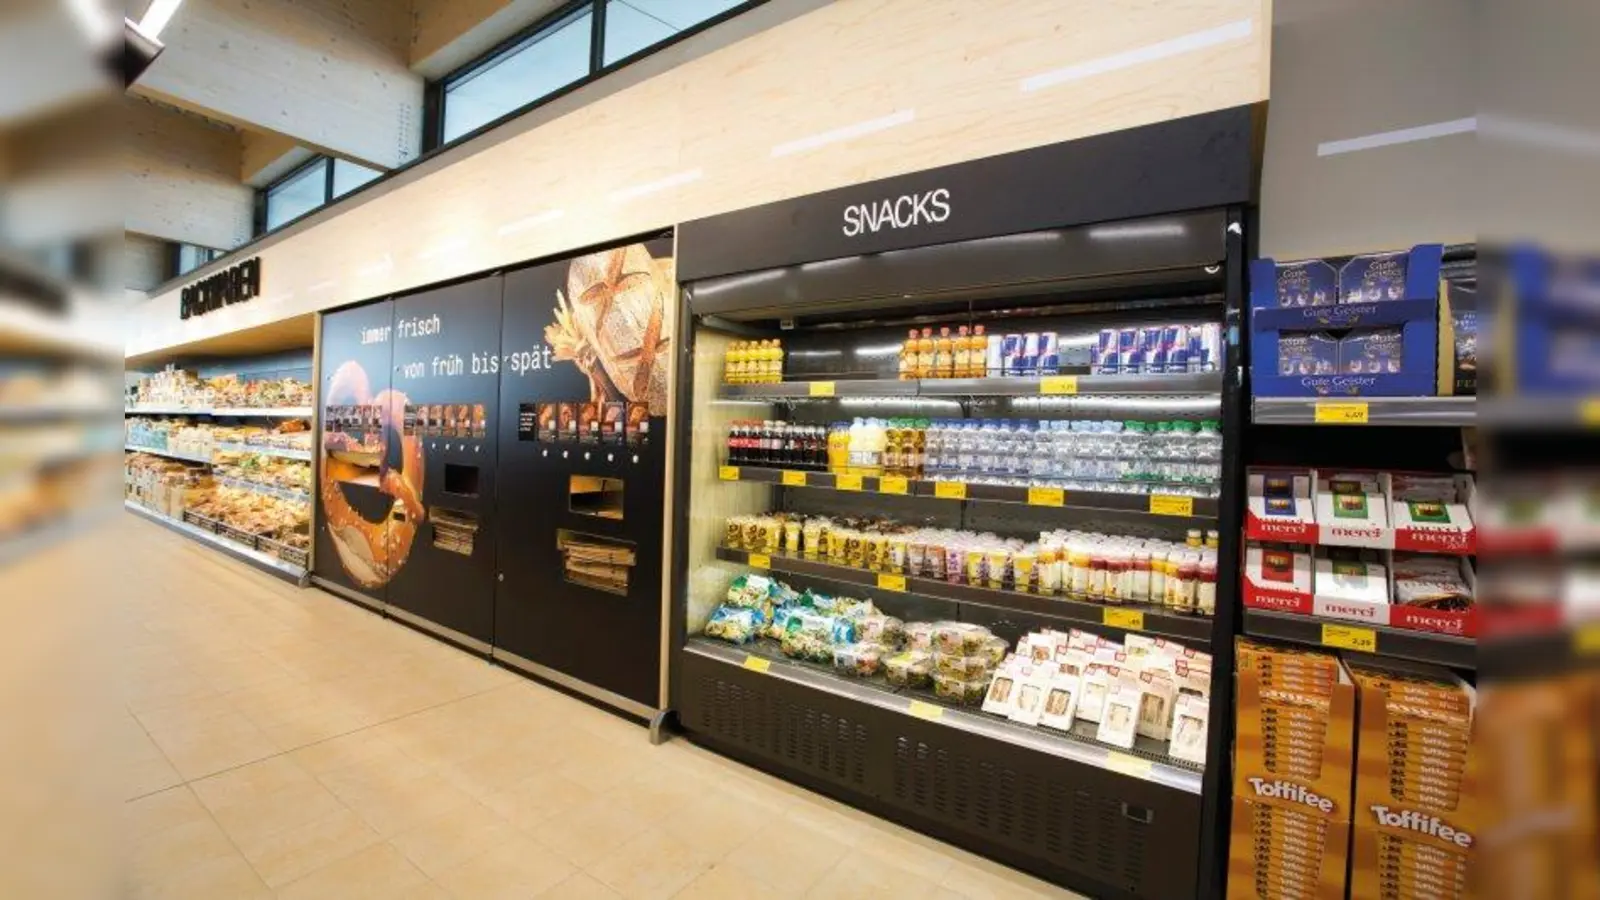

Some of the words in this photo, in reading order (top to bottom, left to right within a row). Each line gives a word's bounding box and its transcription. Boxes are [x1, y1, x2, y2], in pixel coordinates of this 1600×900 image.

[843, 188, 951, 237] SNACKS
[397, 313, 441, 339] frisch
[403, 362, 426, 379] von
[431, 354, 464, 378] früh
[471, 351, 500, 375] bis
[510, 343, 552, 378] spät
[1300, 376, 1330, 388] Gute
[1331, 375, 1378, 388] Geister
[1260, 523, 1308, 535] merci
[1331, 526, 1382, 539] merci
[1411, 530, 1468, 544] merci
[1255, 594, 1301, 608] merci
[1324, 603, 1377, 618] merci
[1405, 614, 1464, 630] merci
[1247, 776, 1334, 813] Toffifee
[1370, 804, 1474, 849] Toffifee
